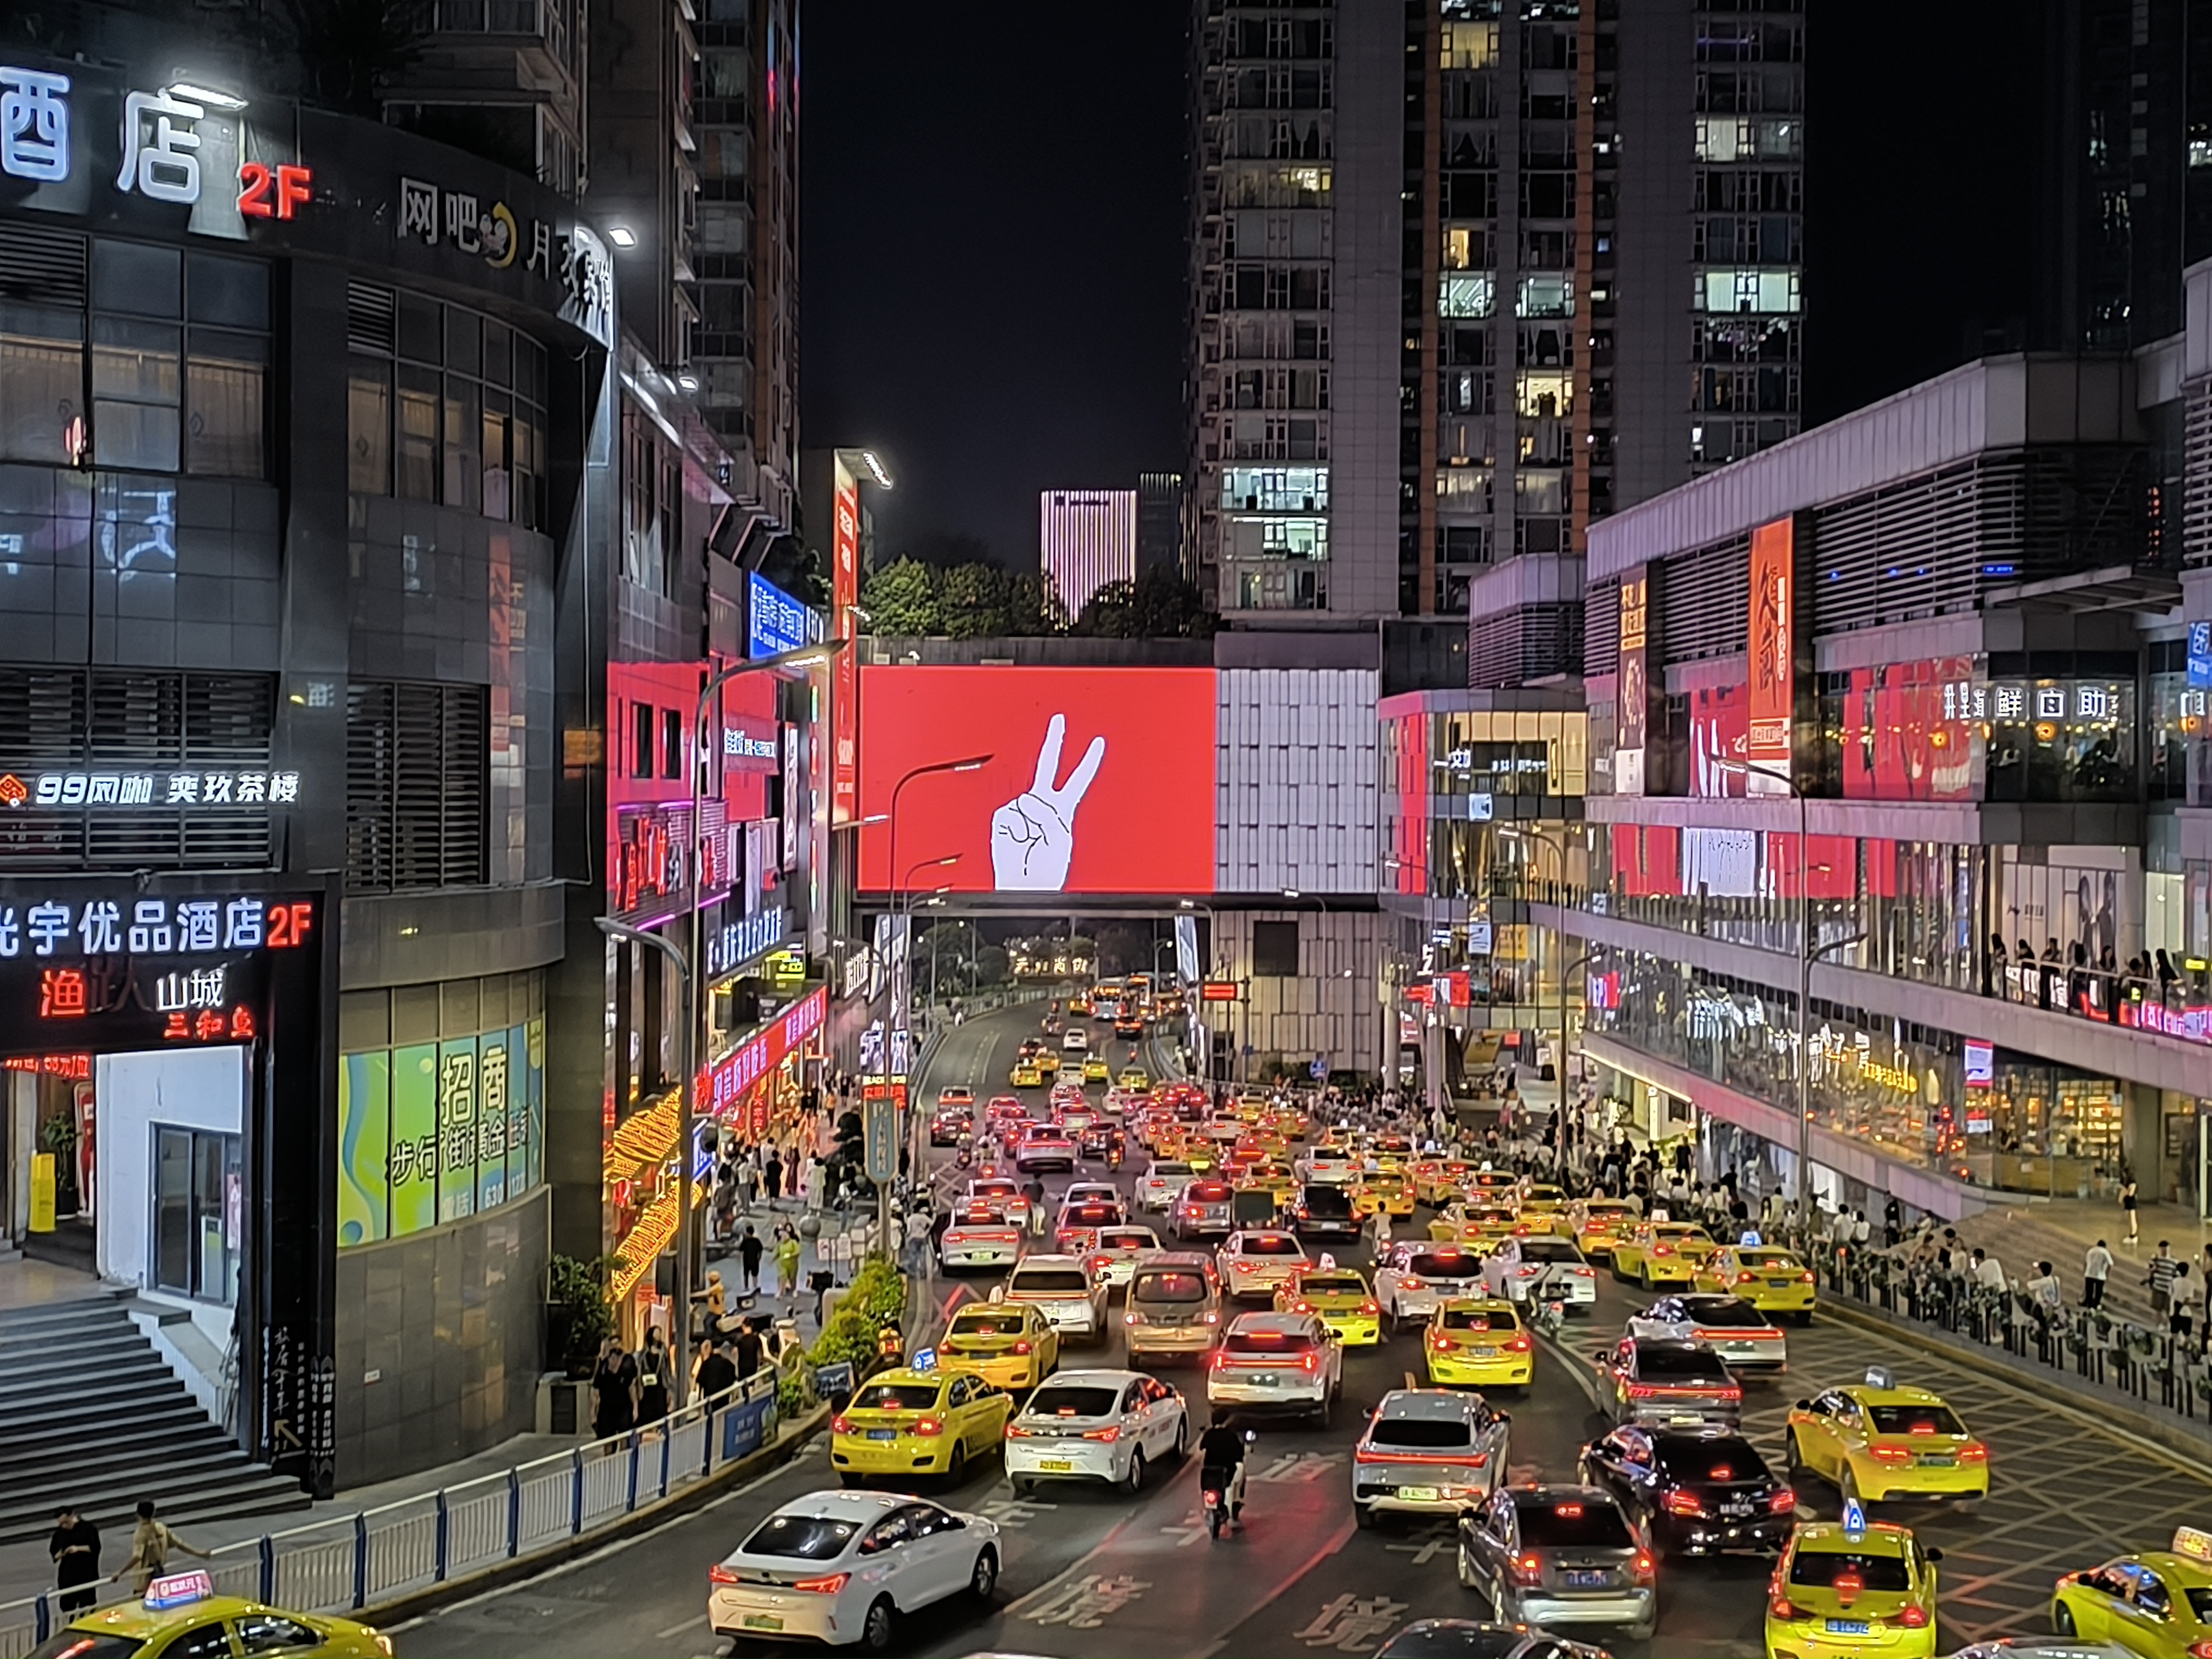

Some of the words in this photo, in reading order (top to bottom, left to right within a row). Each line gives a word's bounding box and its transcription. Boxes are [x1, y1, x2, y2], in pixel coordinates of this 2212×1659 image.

[237, 163, 312, 218] 2F
[397, 177, 480, 253] 网吧
[35, 775, 153, 804] 99网咖
[166, 772, 299, 803] 奕玖茶楼
[266, 903, 312, 948] 2F
[156, 968, 225, 1012] 山城
[441, 1046, 507, 1126] 招商
